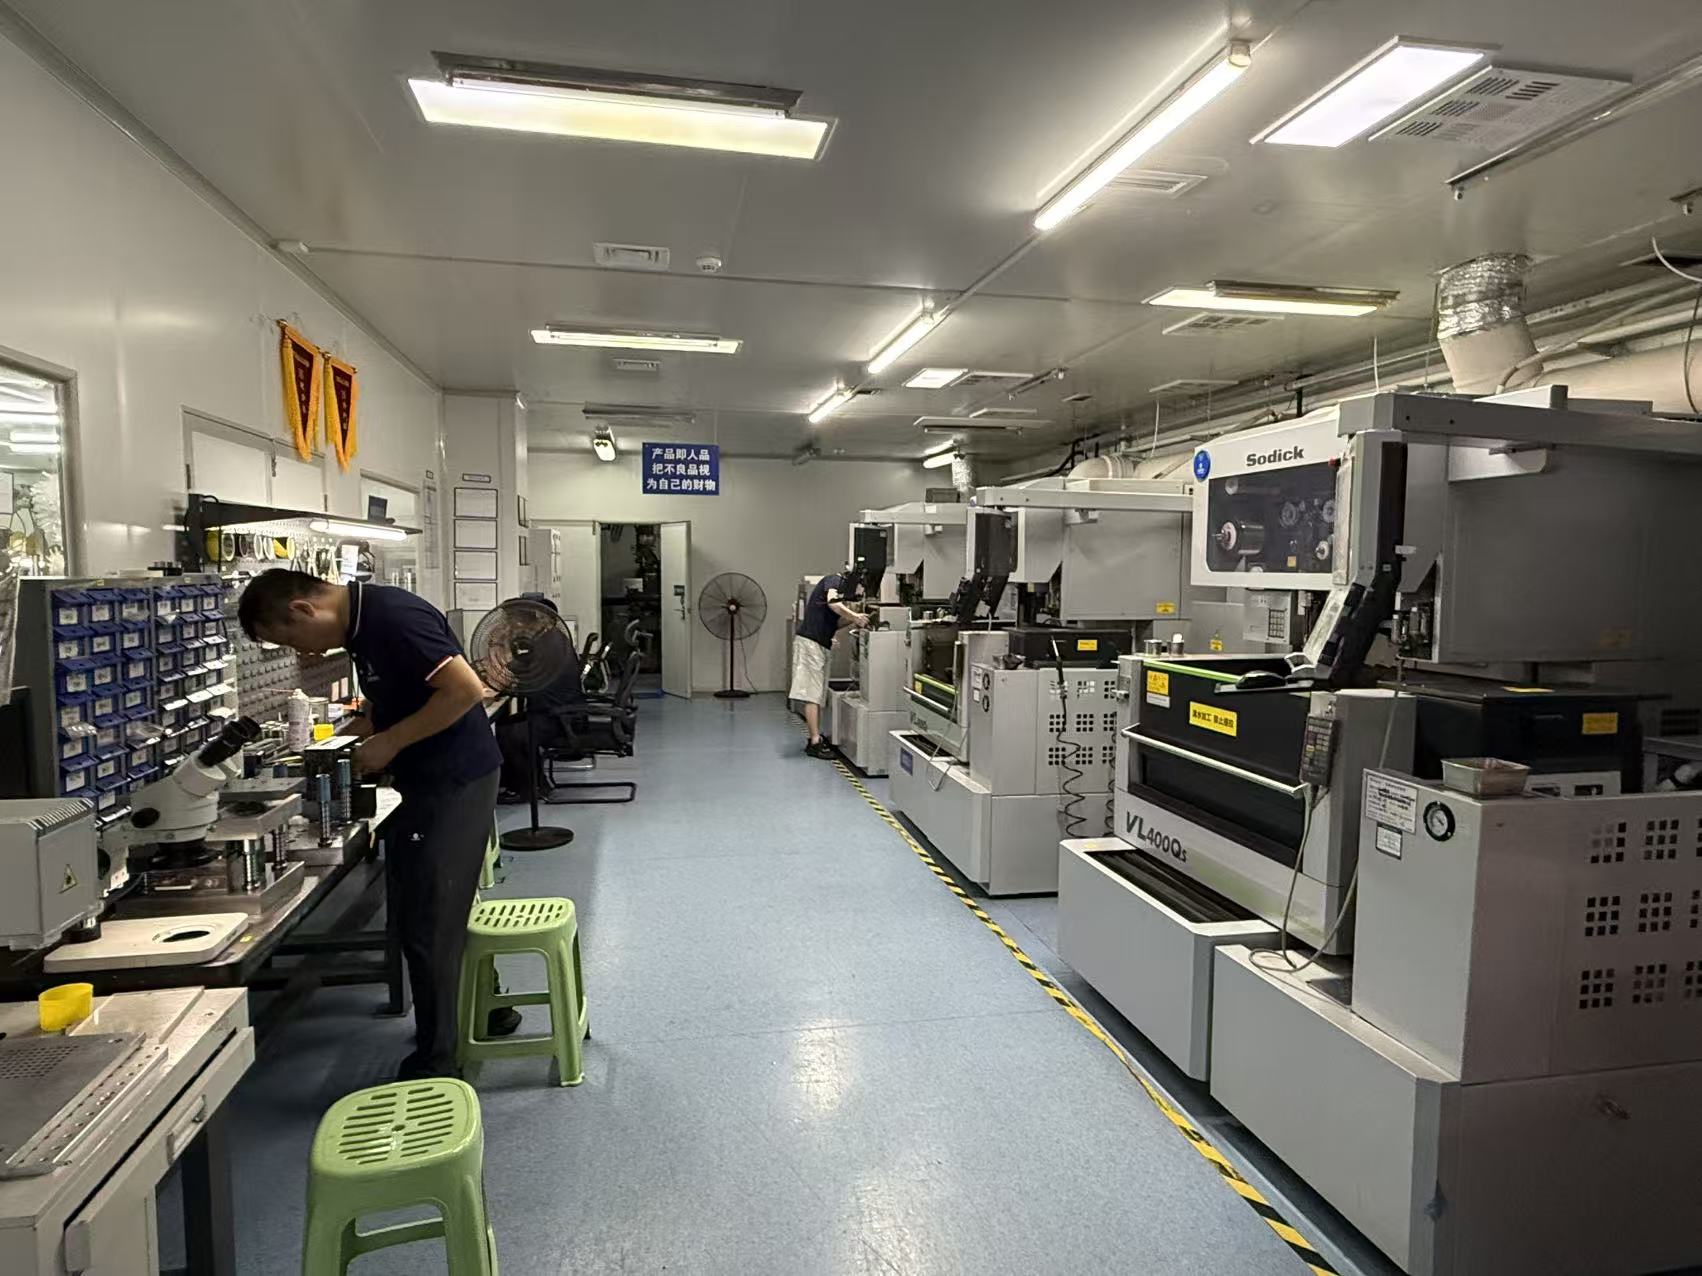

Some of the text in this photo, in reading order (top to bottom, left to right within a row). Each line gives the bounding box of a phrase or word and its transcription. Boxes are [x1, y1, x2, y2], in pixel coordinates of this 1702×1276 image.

[652, 448, 710, 461] 产品即人品
[1246, 446, 1304, 467] Sodick
[652, 463, 710, 476] 把不良品视
[647, 478, 716, 491] 为自己的财物
